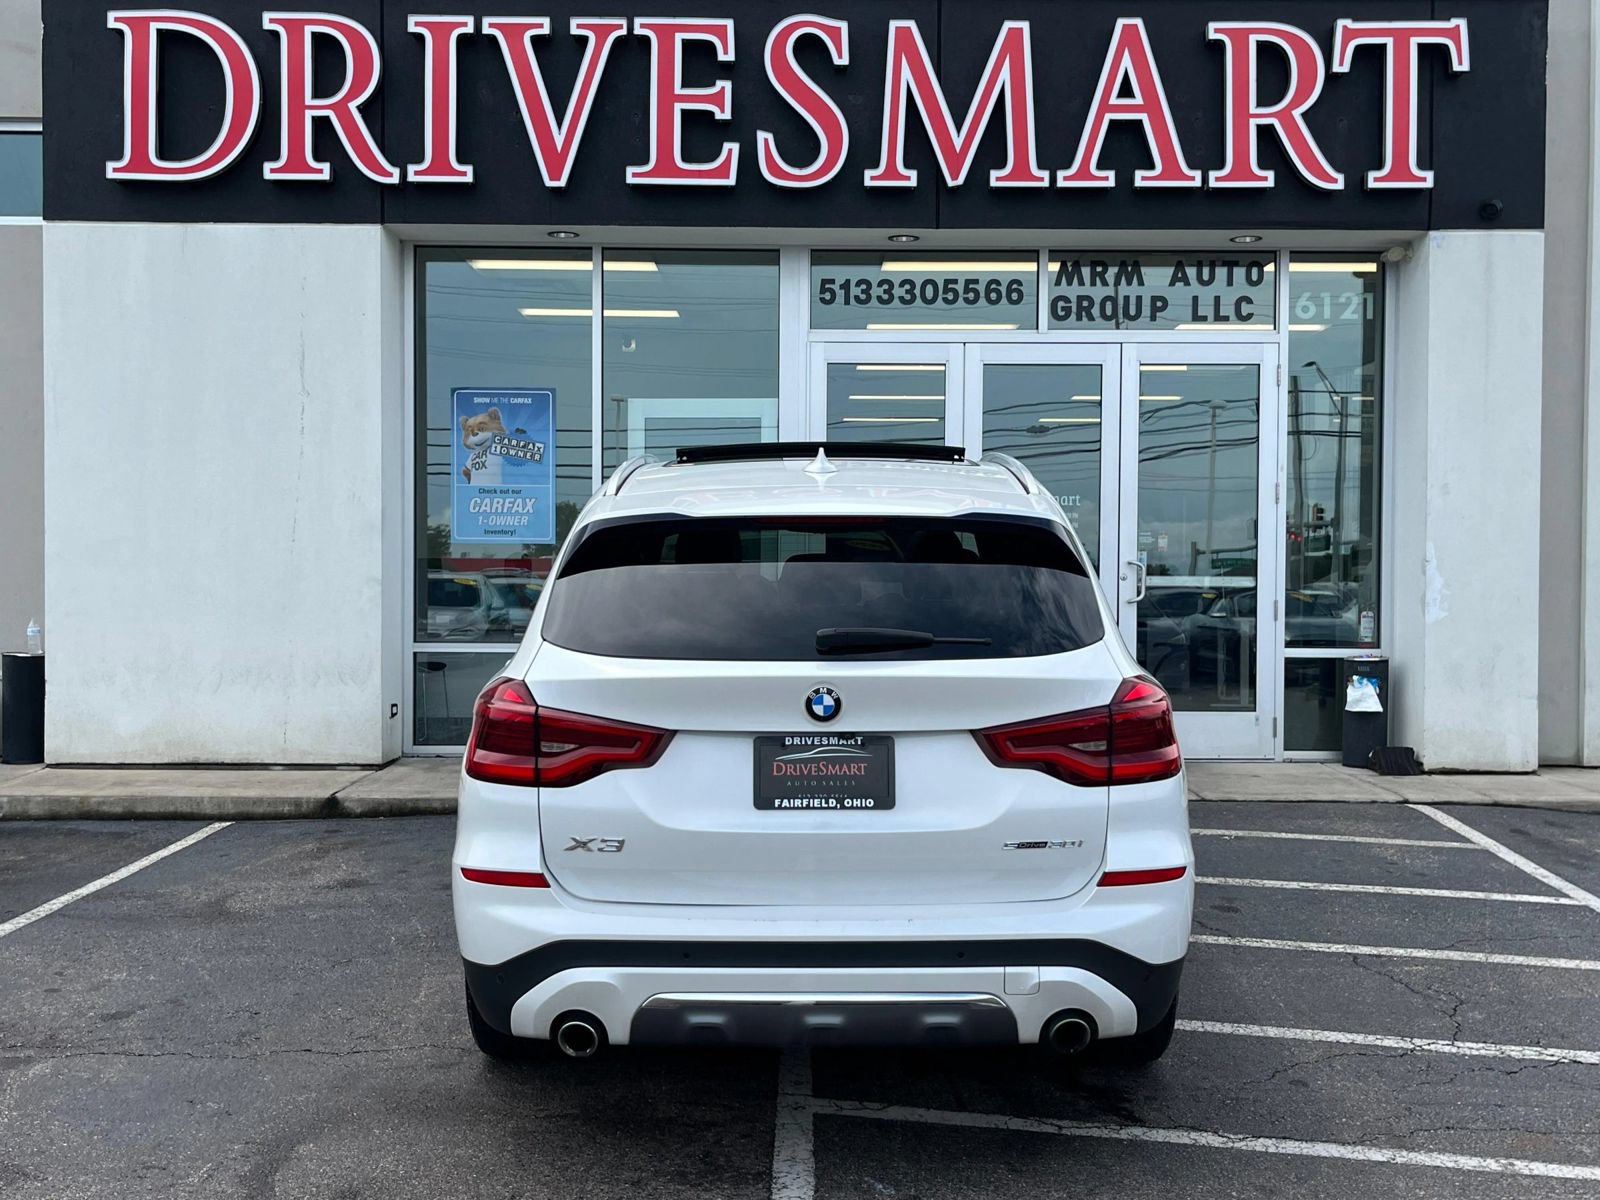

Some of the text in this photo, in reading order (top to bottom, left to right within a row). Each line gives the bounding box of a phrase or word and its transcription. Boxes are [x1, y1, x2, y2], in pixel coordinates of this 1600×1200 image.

[105, 9, 1470, 191] DRIVESMART
[1054, 260, 1265, 287] MRM AUTO
[818, 278, 1025, 306] 5133305566
[1050, 295, 1255, 322] GROUP LLC
[1294, 291, 1375, 320] 6121
[494, 434, 543, 453] CARFAX
[469, 497, 537, 514] CARFAX
[478, 515, 529, 526] 1-OWNER
[484, 528, 517, 536] Inventory!
[785, 736, 864, 745] DRIVESMART
[774, 798, 875, 809] FAIRFIELD, OHIO
[563, 836, 625, 852] X3
